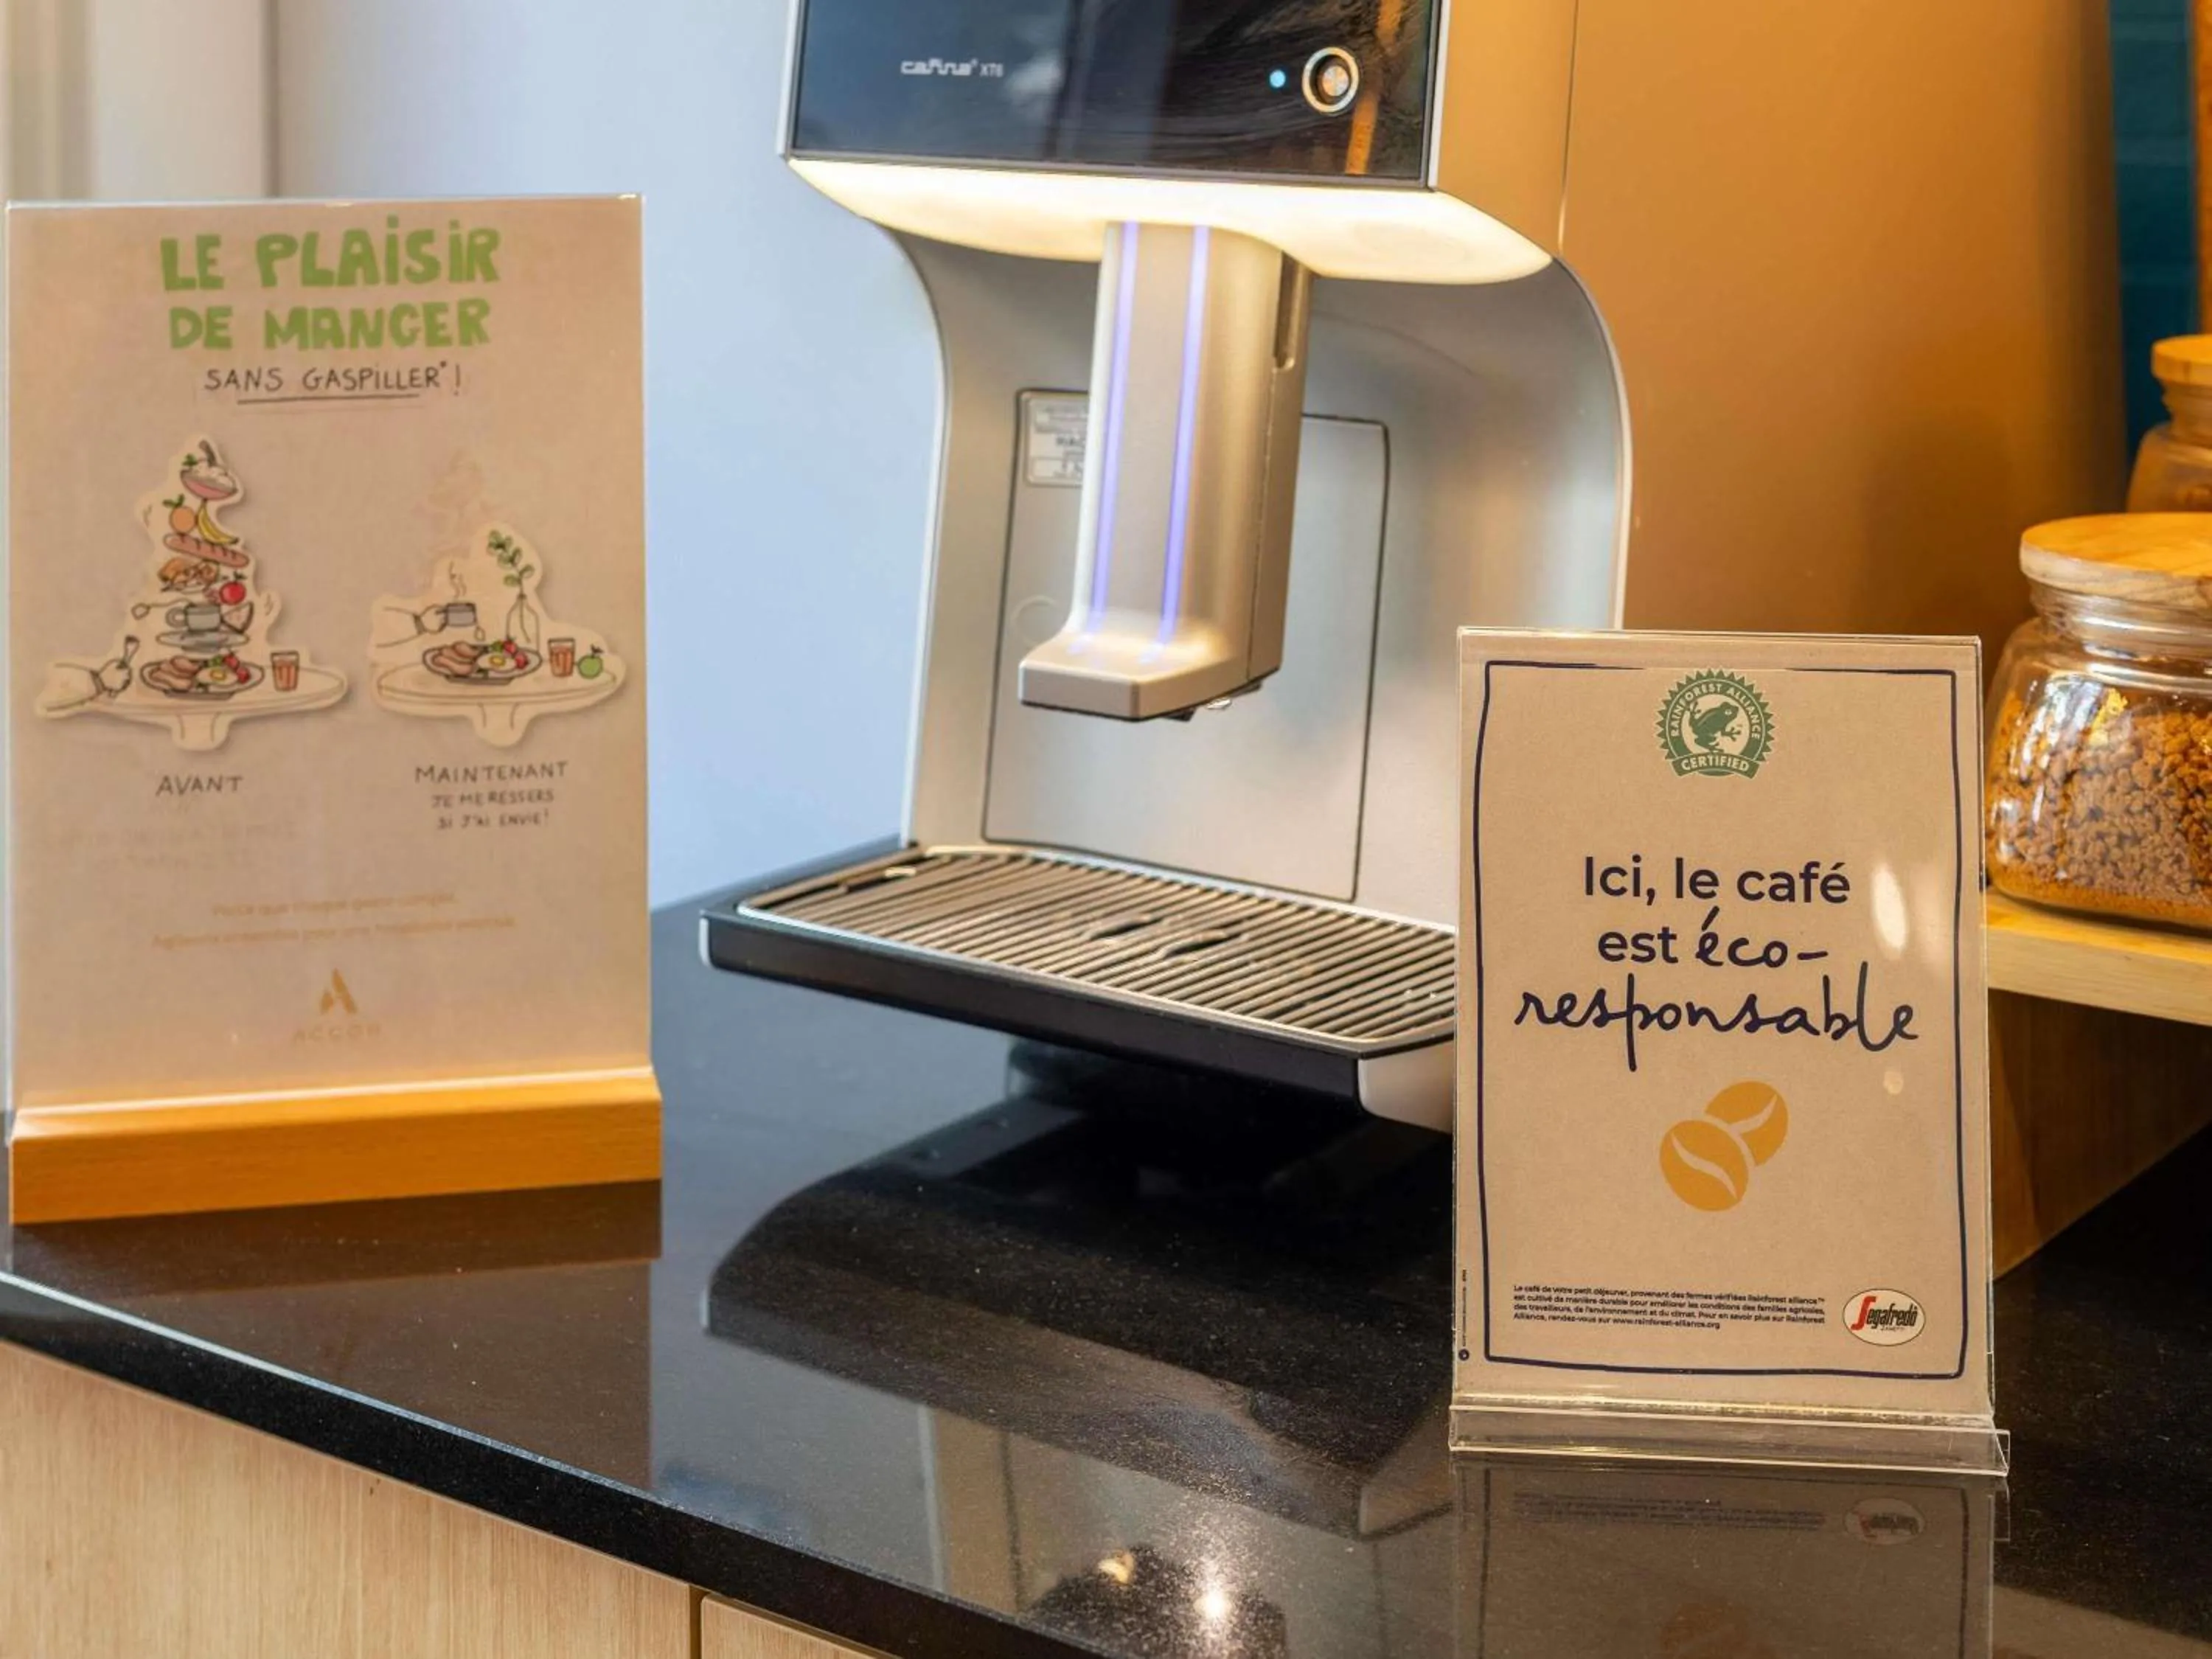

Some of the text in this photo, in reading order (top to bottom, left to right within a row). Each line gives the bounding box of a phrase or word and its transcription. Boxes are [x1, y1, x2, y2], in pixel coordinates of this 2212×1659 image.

[160, 234, 224, 291] LE
[169, 298, 490, 350] DE MANGER
[204, 367, 284, 392] SANS
[1670, 684, 1762, 739] RAINFOREST ALLIANCE
[156, 774, 243, 797] AVANT
[414, 760, 567, 784] MAINTENANT
[1680, 756, 1750, 772] CERTIFIED
[1585, 854, 1850, 906] Ici, le café
[1598, 927, 1679, 963] est
[1514, 961, 1919, 1072] responsable
